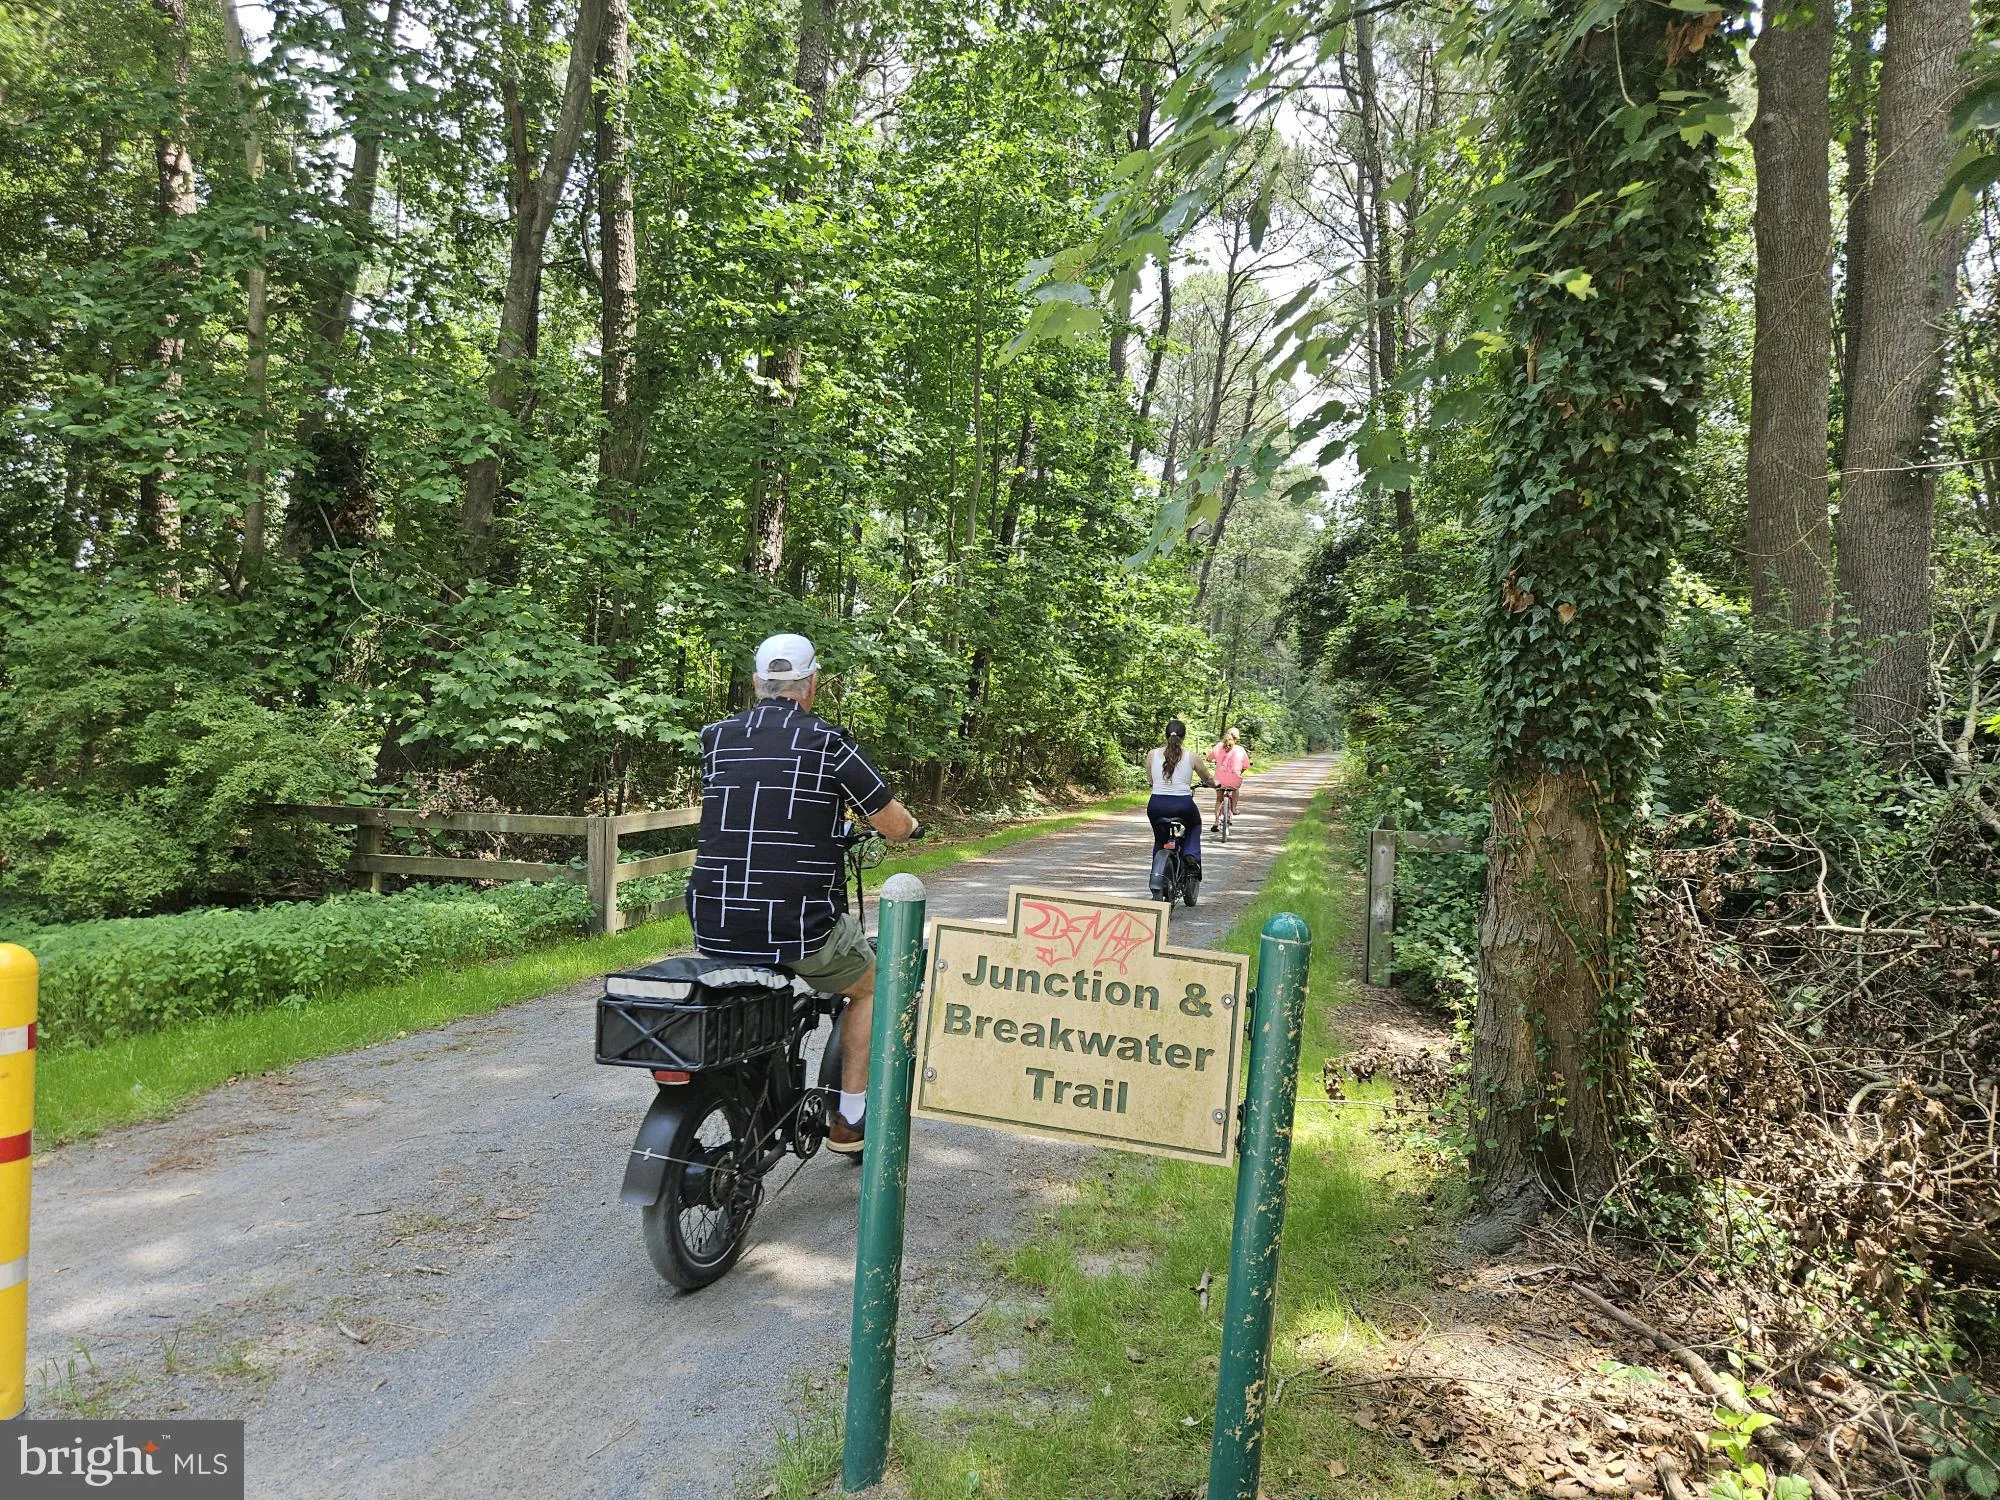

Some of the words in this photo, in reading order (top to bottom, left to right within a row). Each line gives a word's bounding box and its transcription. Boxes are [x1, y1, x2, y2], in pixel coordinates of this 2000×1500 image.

[962, 955, 1160, 1011] Junction
[1178, 982, 1214, 1018] &
[943, 1003, 1216, 1072] Breakwater
[1026, 1067, 1129, 1114] Trail
